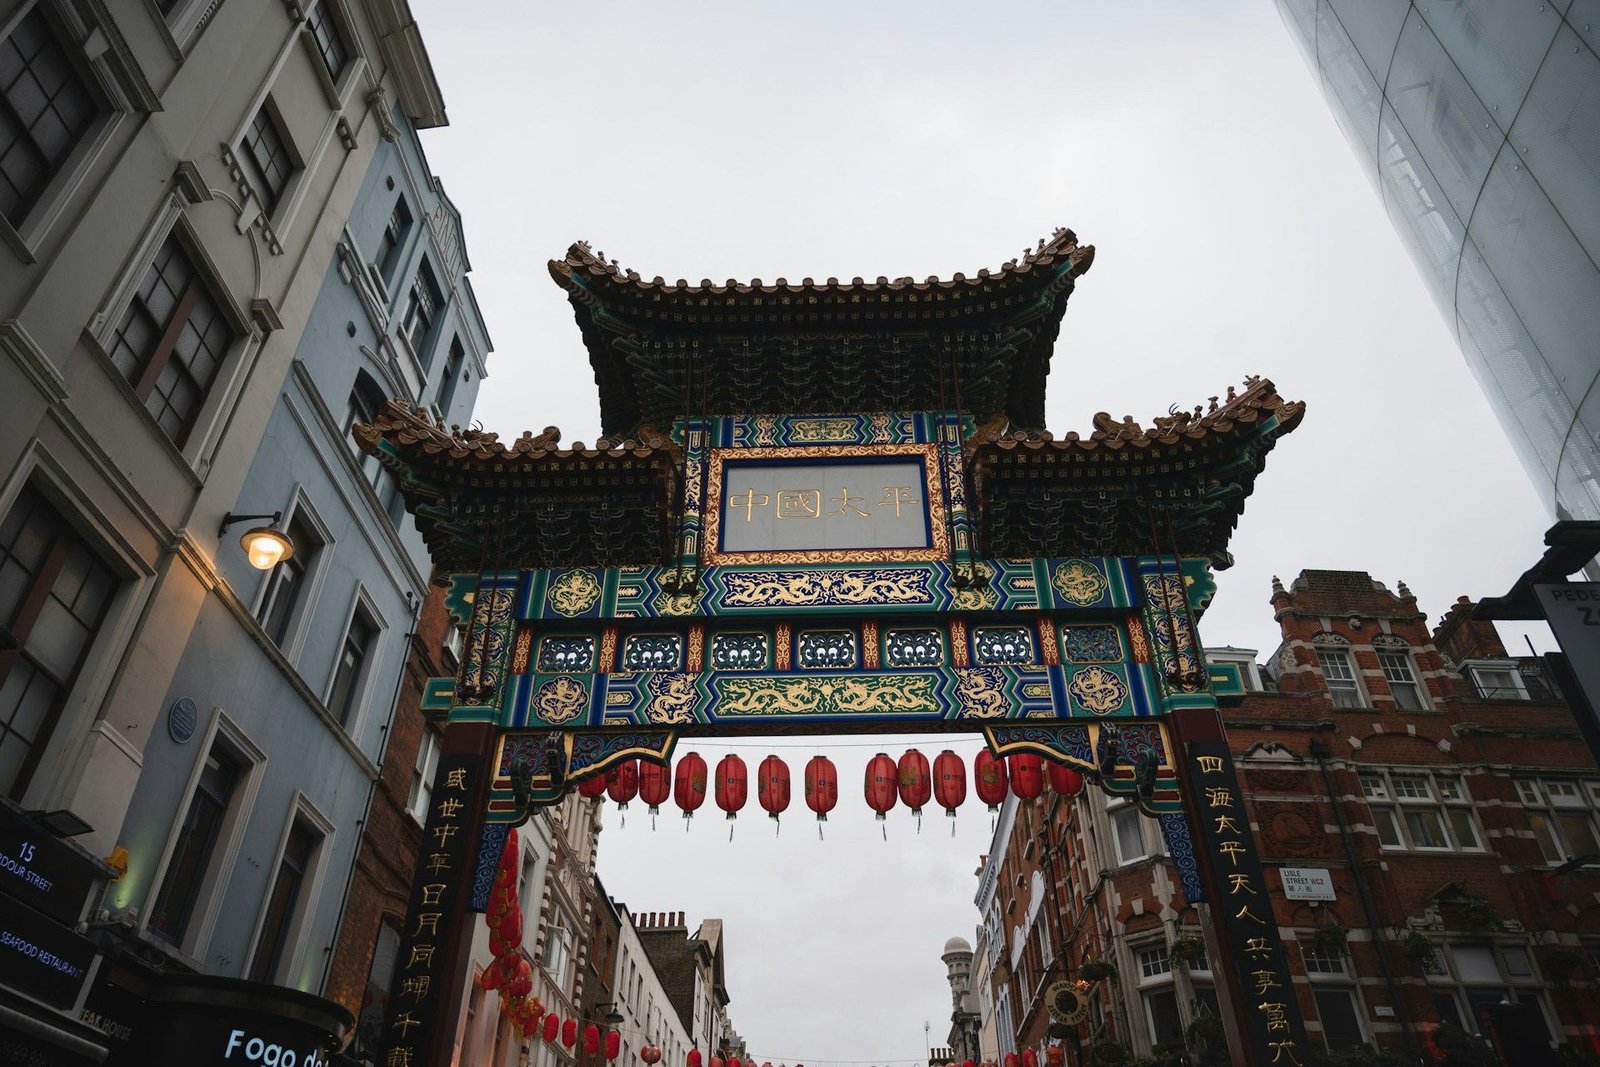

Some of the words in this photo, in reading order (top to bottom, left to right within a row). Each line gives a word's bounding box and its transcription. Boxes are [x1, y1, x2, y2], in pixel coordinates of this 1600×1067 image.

[730, 486, 920, 523] 中國太平
[1577, 607, 1600, 625] Z
[19, 841, 36, 863] 15
[25, 870, 54, 892] STREET
[0, 930, 39, 958] SEAFOOD
[37, 949, 83, 979] RESTAURANT
[102, 1018, 132, 1040] HOUSE
[224, 1029, 297, 1067] Fogo
